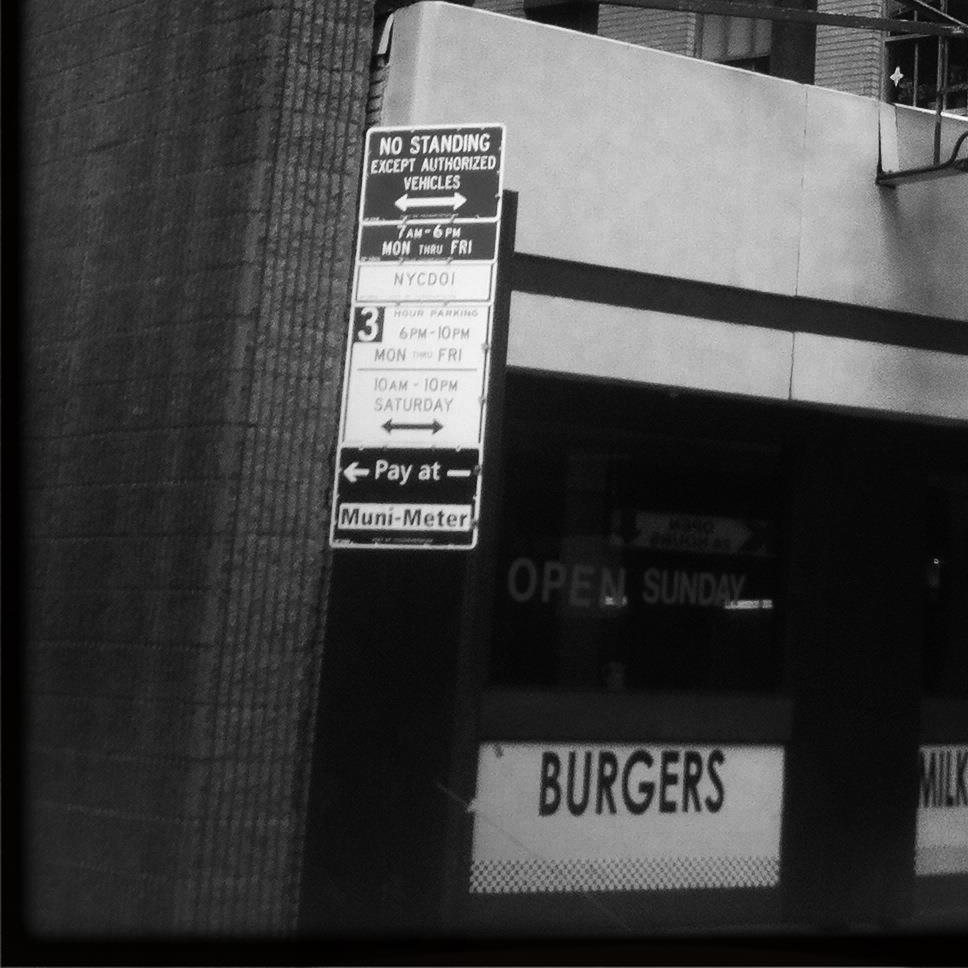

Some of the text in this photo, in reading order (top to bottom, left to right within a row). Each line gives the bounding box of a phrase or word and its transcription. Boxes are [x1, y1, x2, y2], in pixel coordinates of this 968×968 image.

[379, 133, 491, 155] NO STANDING
[370, 155, 496, 174] EXCEPT AUTHORIZED
[404, 175, 460, 190] VEHICLES
[382, 240, 472, 256] MON THRU FRI
[394, 272, 455, 286] NYCDOI
[358, 306, 479, 342] 3 HOUR PARKING
[374, 349, 406, 362] MON
[438, 348, 462, 362] FRI
[374, 398, 453, 412] SATURDAY
[374, 459, 441, 486] Pay at
[341, 507, 467, 527] Muni-Meter
[507, 557, 746, 608] OPEN SUNDAY
[539, 749, 726, 817] BURGERS
[919, 750, 968, 808] MILK
